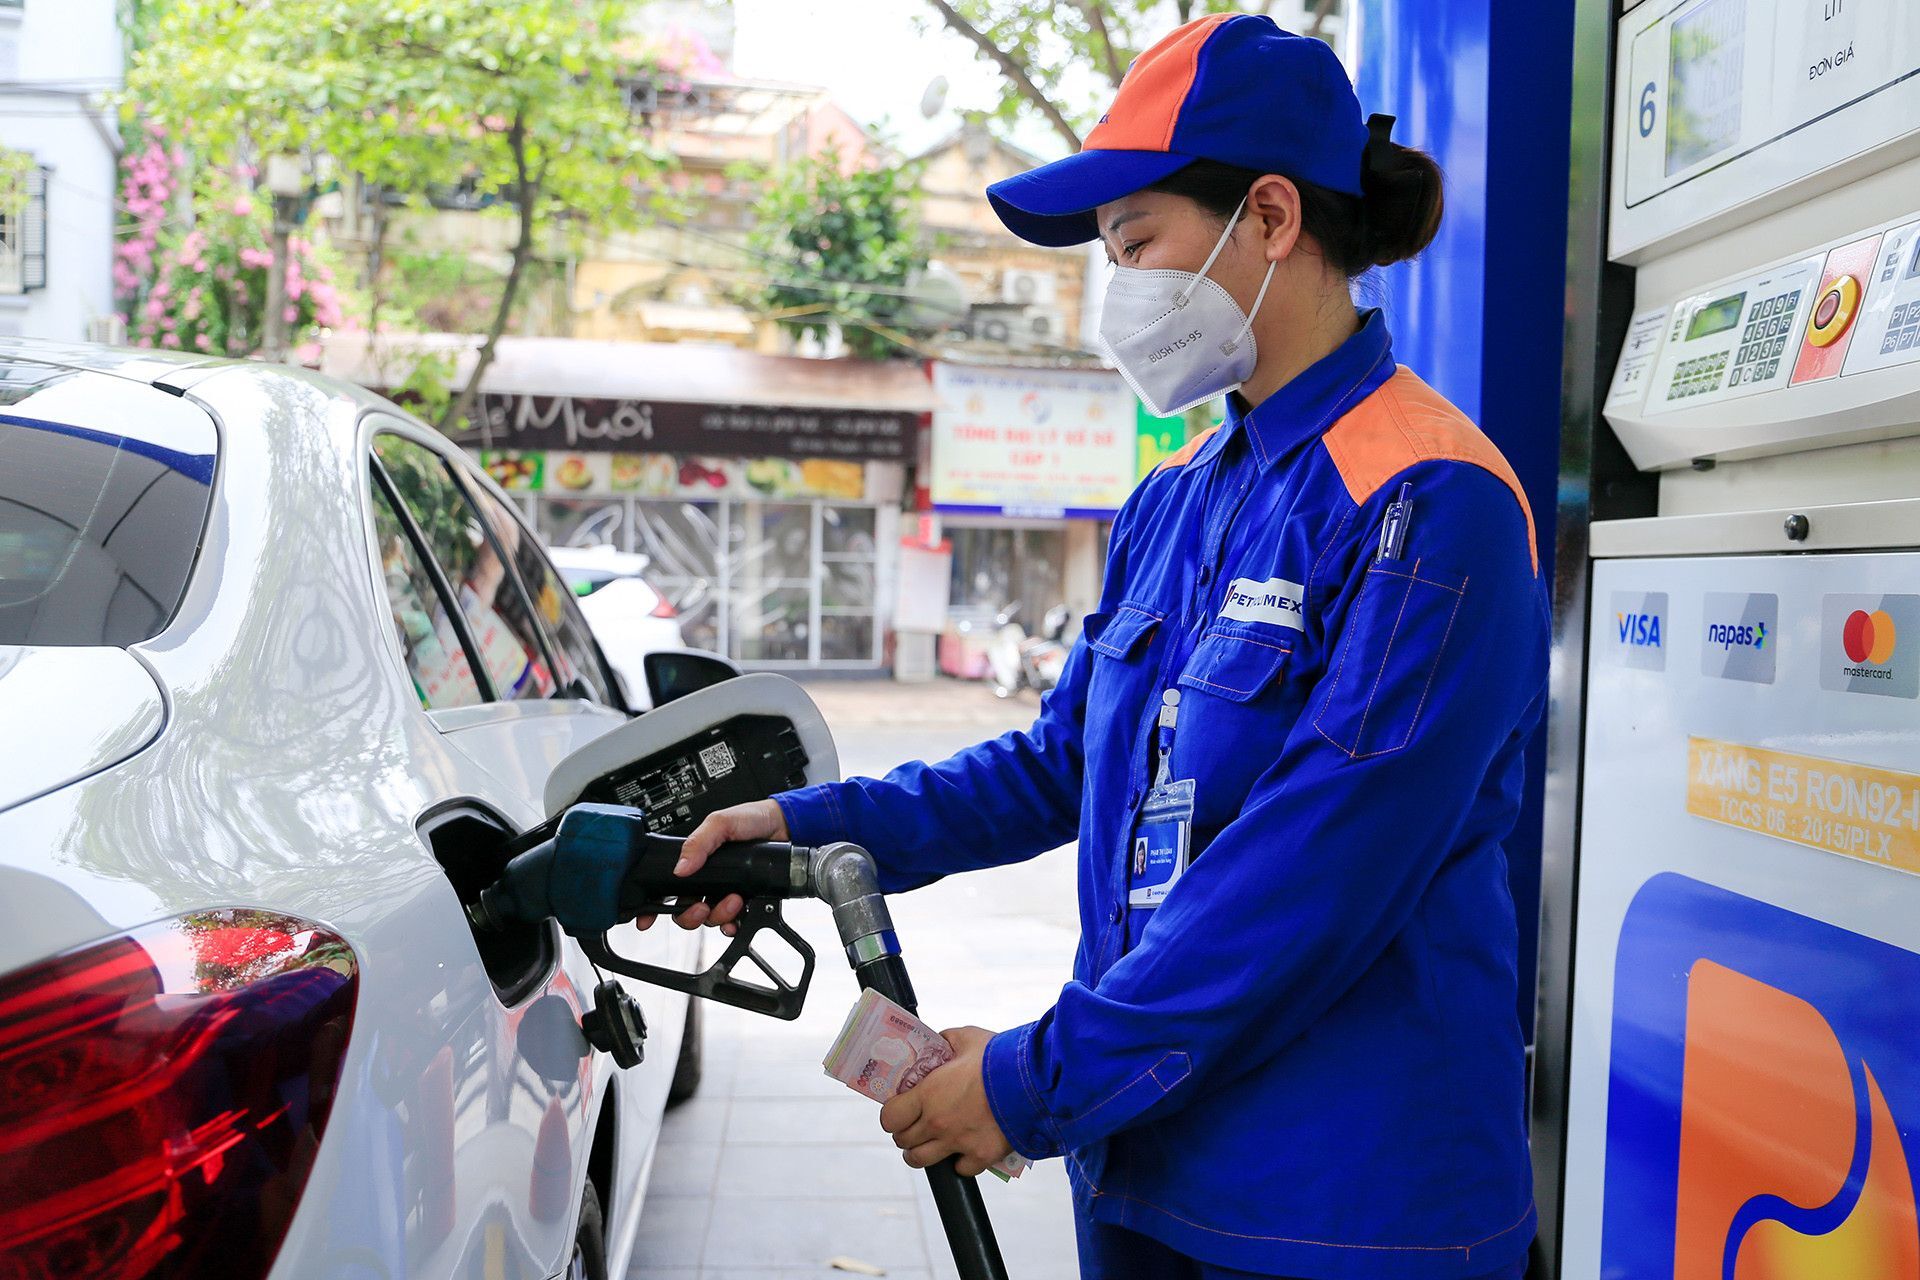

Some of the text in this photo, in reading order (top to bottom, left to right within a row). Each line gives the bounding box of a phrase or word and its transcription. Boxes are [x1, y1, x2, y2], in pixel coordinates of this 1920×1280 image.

[1809, 41, 1854, 80] ĐƠN GIÁ
[1639, 81, 1656, 138] 6
[1892, 310, 1905, 324] P1
[1148, 329, 1202, 363] BUSH TS-95
[1883, 335, 1896, 349] P6
[1899, 331, 1912, 345] P7
[1229, 591, 1303, 614] PETMEX
[1617, 612, 1661, 648] VISA
[1708, 623, 1753, 650] napas
[1768, 763, 1799, 804] E5
[660, 814, 673, 825] 95
[1719, 796, 1762, 827] TCCS
[1767, 808, 1785, 833] 06
[1802, 816, 1892, 861] 2015/PLX
